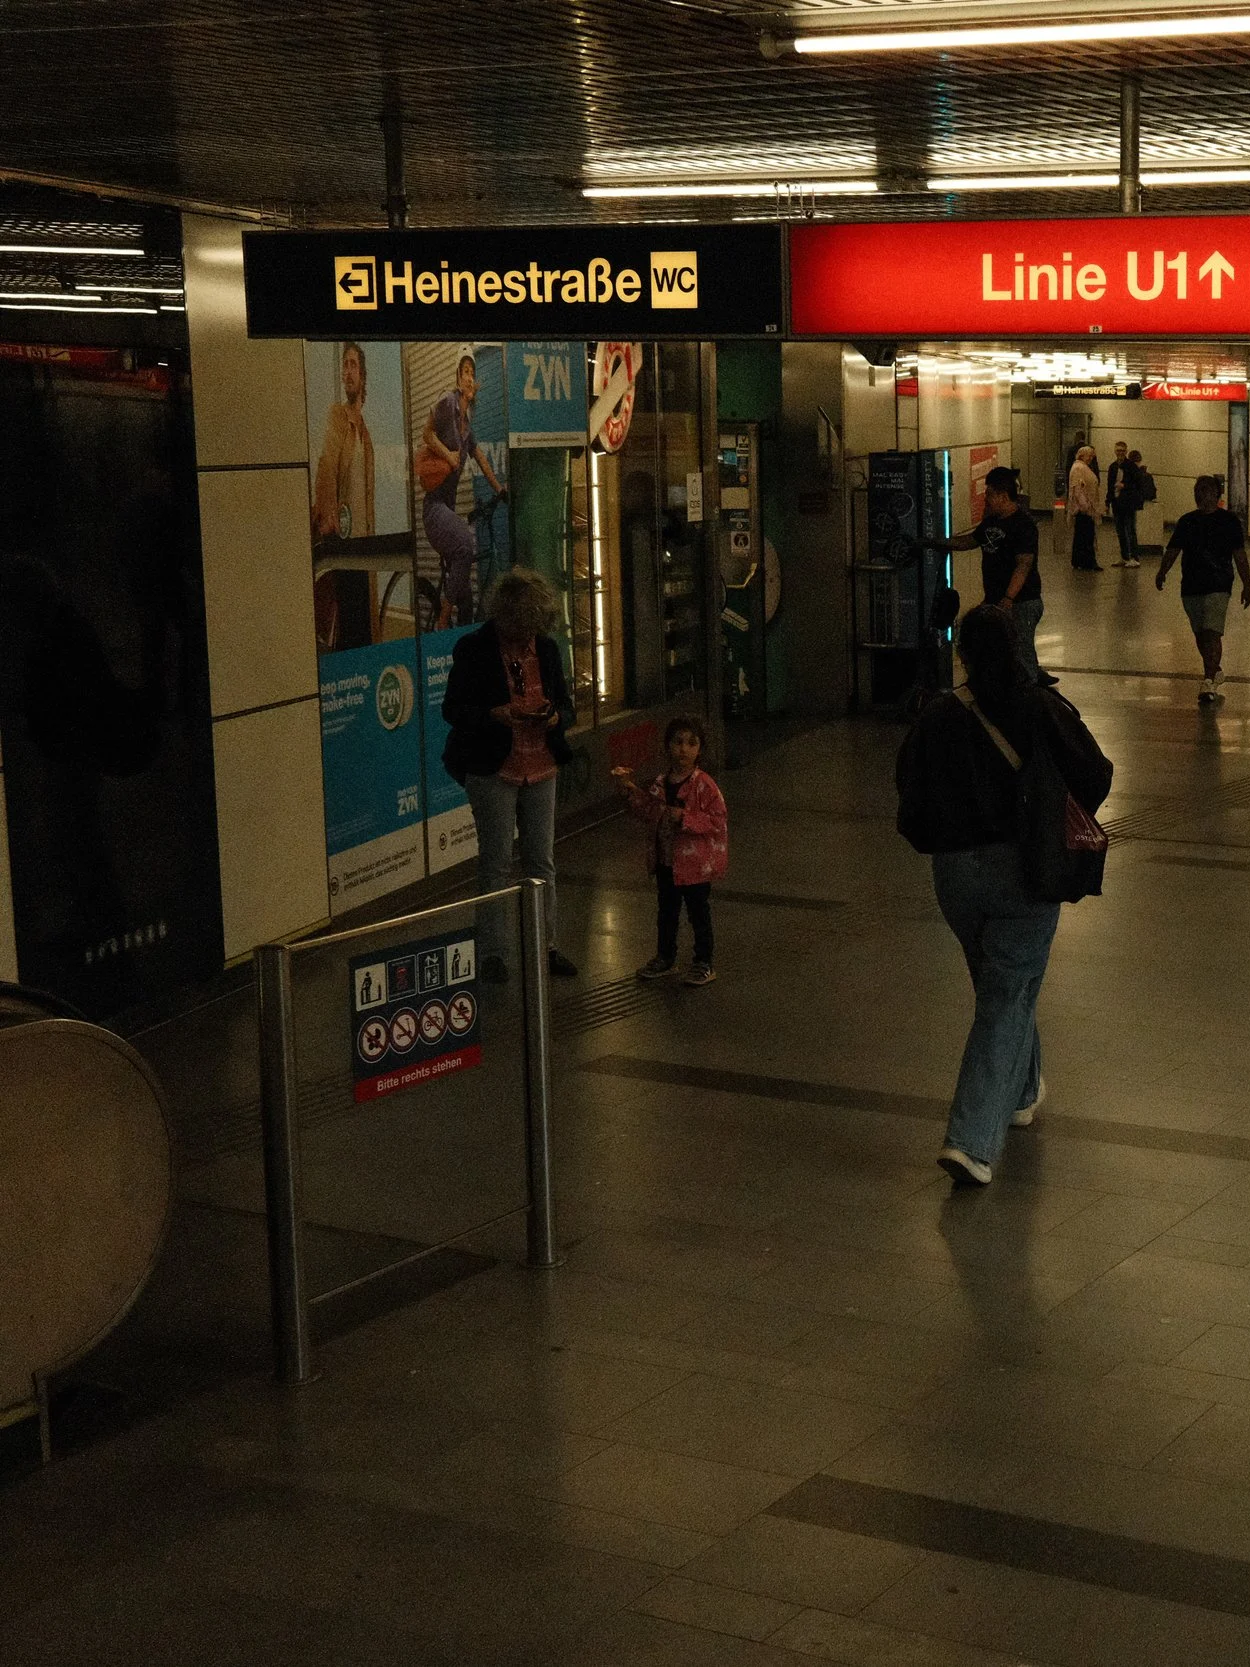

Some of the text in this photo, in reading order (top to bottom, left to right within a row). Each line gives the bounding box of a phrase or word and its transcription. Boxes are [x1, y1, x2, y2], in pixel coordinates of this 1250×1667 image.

[384, 257, 696, 304] Heinestraße WC
[982, 250, 1188, 301] Linie U1
[523, 353, 572, 401] ZYN
[320, 681, 337, 697] eep
[380, 687, 401, 709] ZYN
[397, 792, 419, 817] ZYN
[376, 1057, 462, 1092] Bitte rechts stehen
